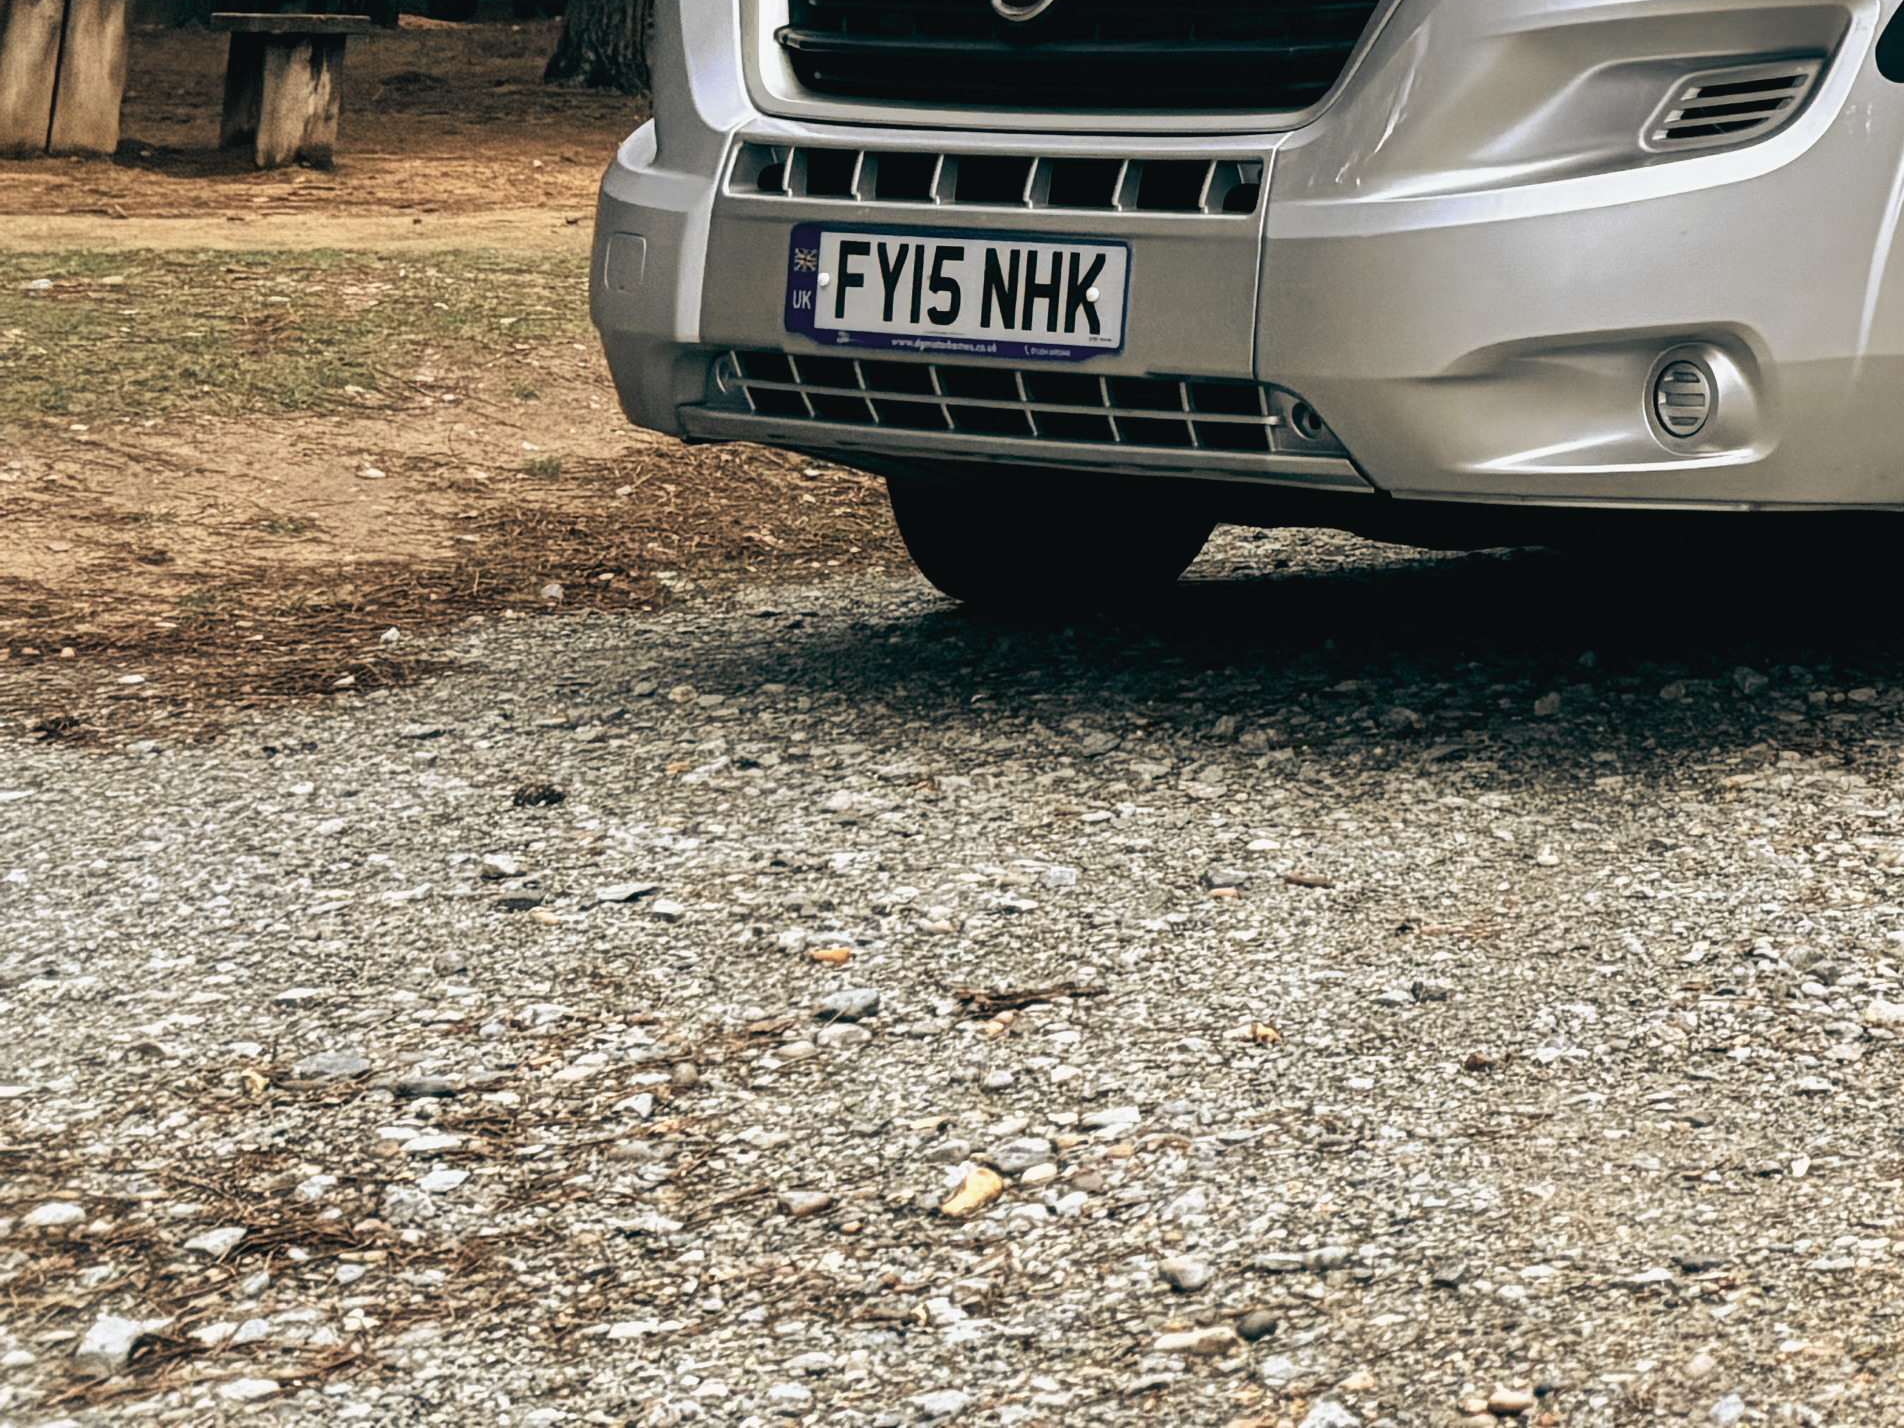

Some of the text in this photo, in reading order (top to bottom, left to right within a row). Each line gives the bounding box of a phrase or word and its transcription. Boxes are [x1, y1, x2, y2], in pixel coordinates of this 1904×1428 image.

[793, 289, 812, 310] UK
[835, 240, 1106, 335] FY15 NHK
